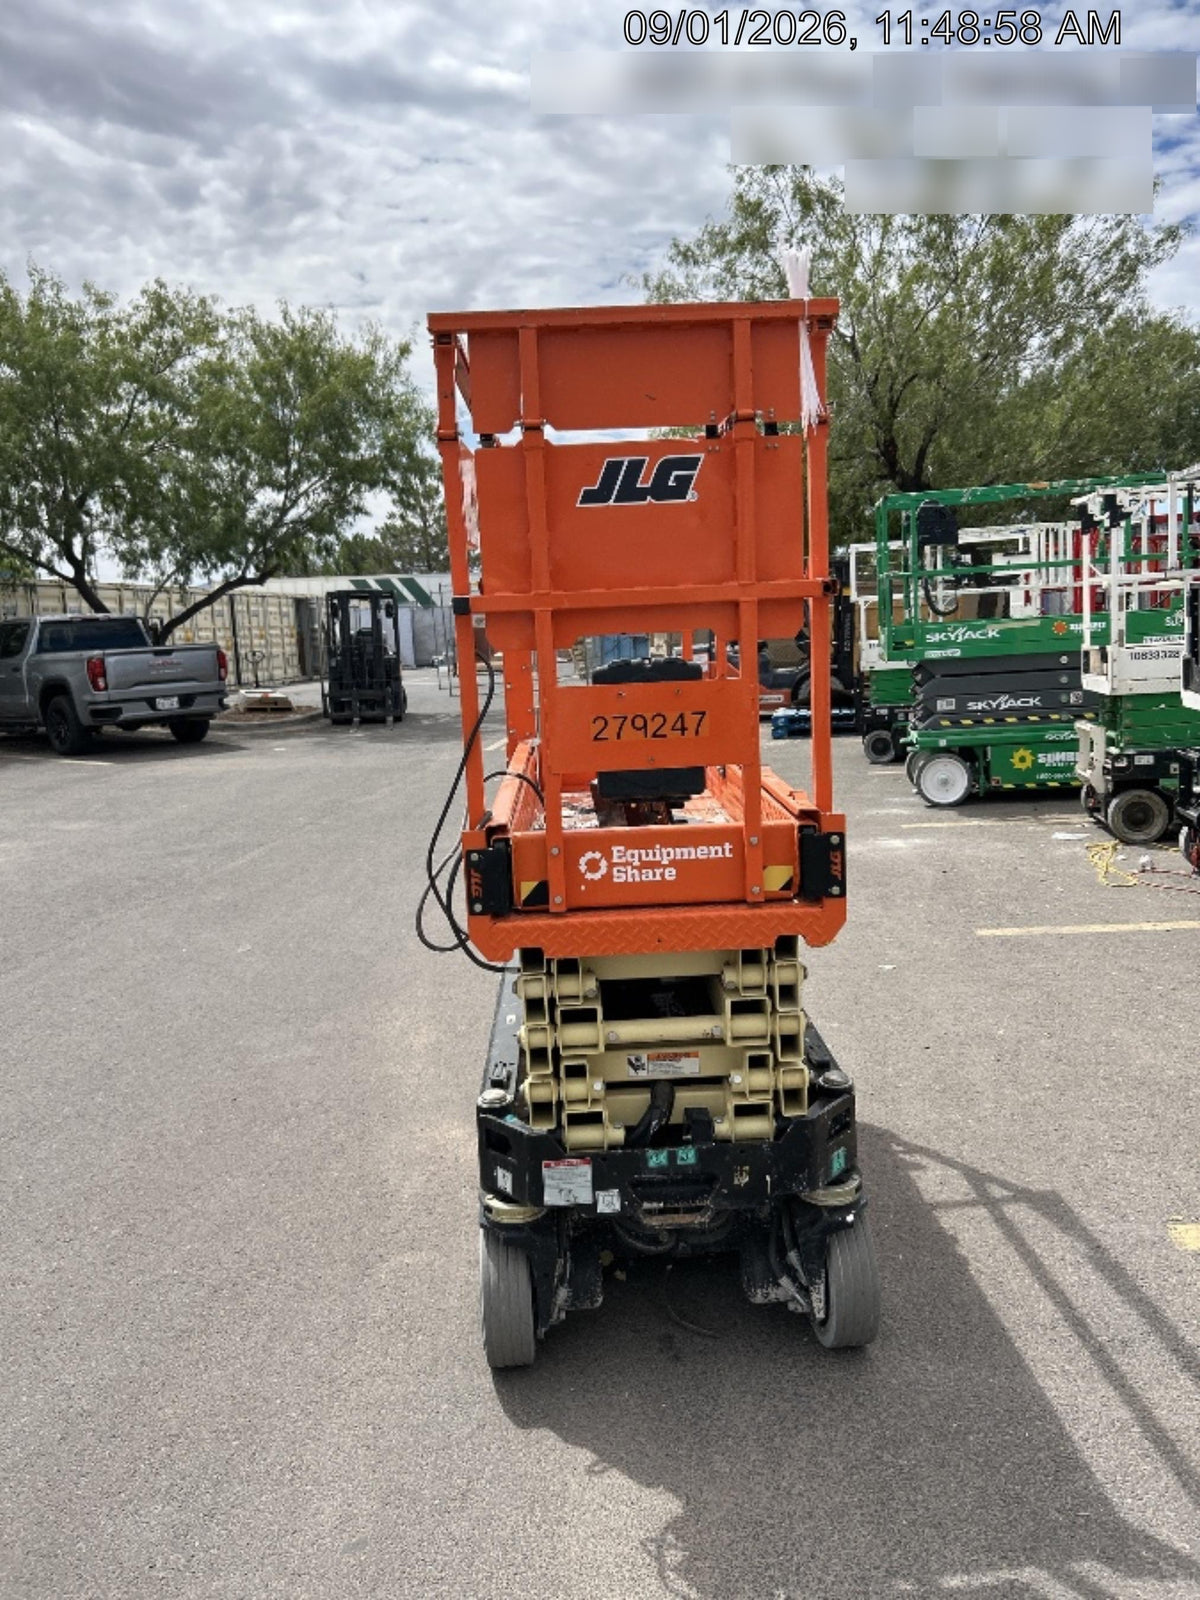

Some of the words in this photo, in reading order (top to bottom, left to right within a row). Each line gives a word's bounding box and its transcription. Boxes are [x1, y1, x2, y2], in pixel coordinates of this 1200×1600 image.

[576, 453, 705, 507] JLG
[925, 625, 1000, 643] SKYJACK
[966, 694, 1042, 710] SKYJACK
[592, 711, 707, 741] 279247
[611, 842, 734, 866] Equipment
[612, 865, 677, 883] Share
